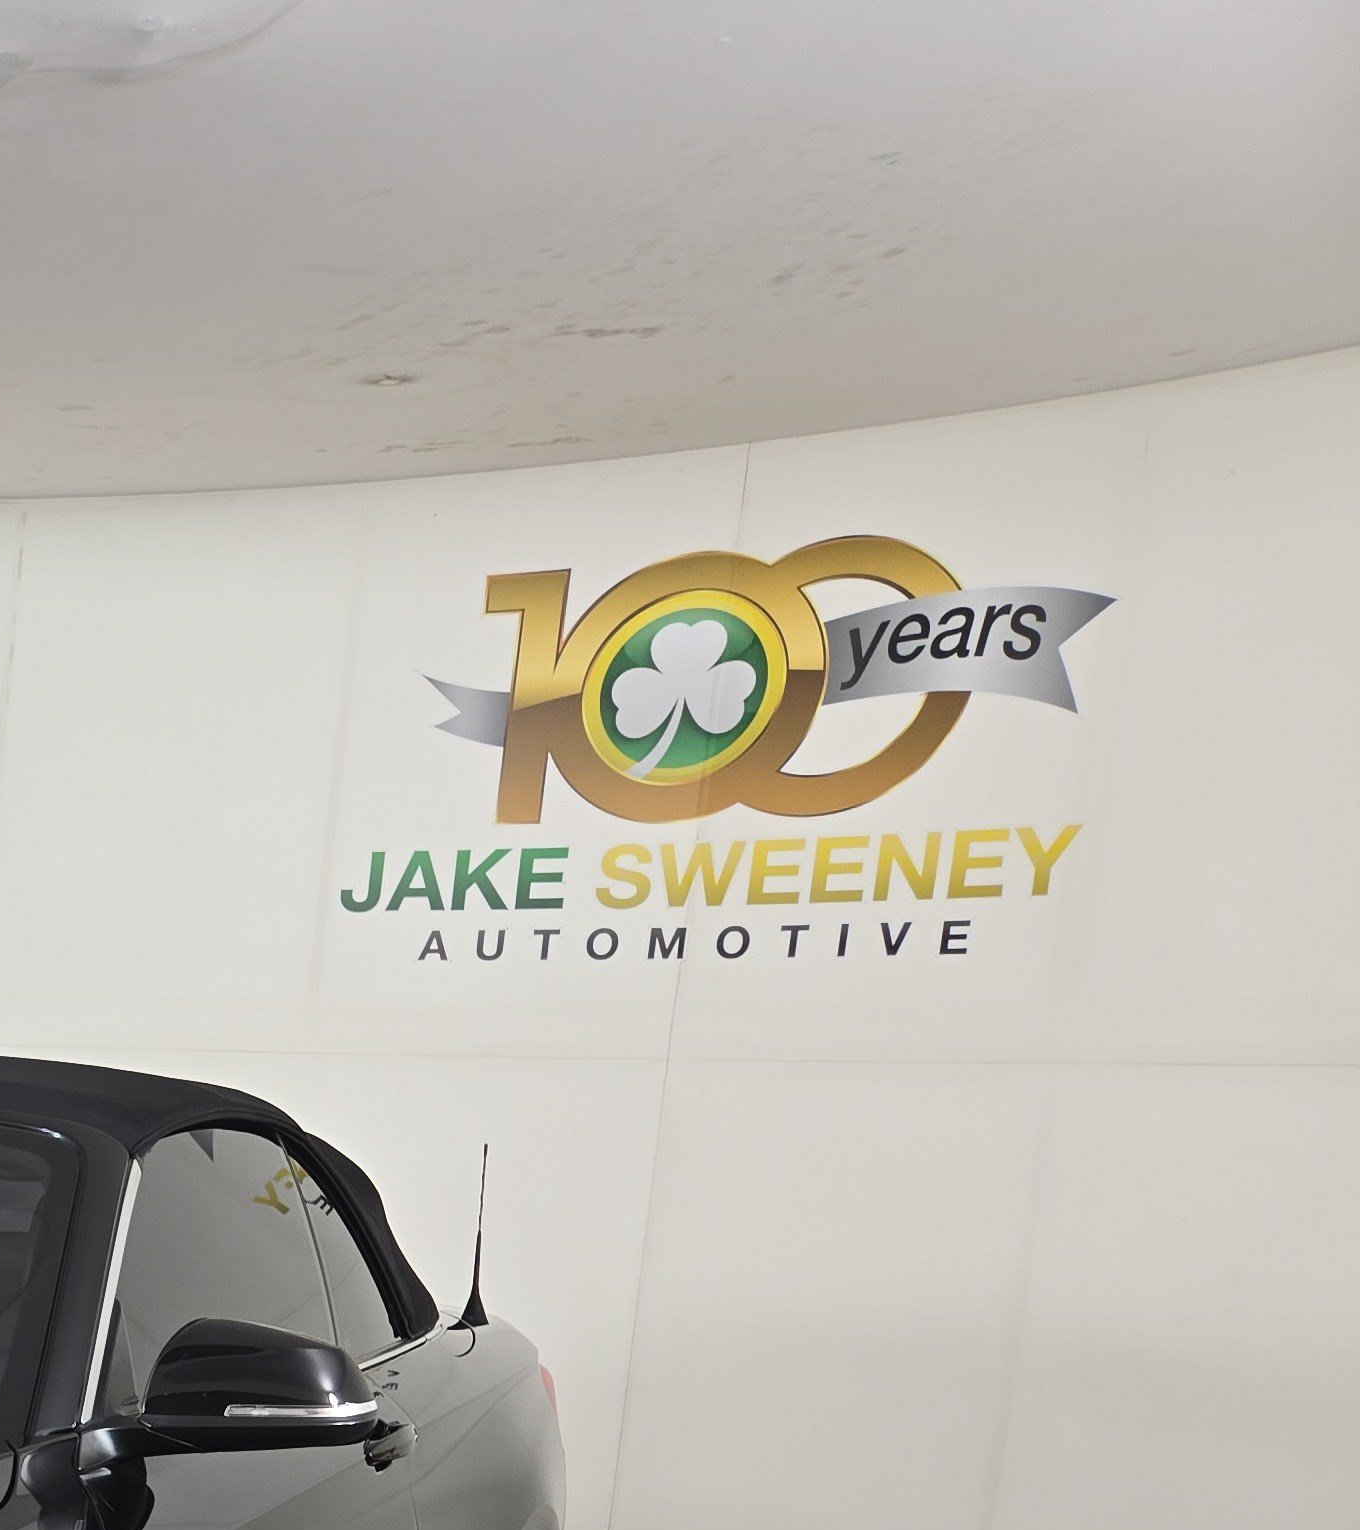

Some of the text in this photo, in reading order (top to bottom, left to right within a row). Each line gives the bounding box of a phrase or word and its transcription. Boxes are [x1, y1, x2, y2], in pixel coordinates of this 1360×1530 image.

[839, 599, 1047, 693] years
[340, 823, 1083, 912] JAKE SWEENEY
[418, 919, 973, 962] AUTOMOTIVE
